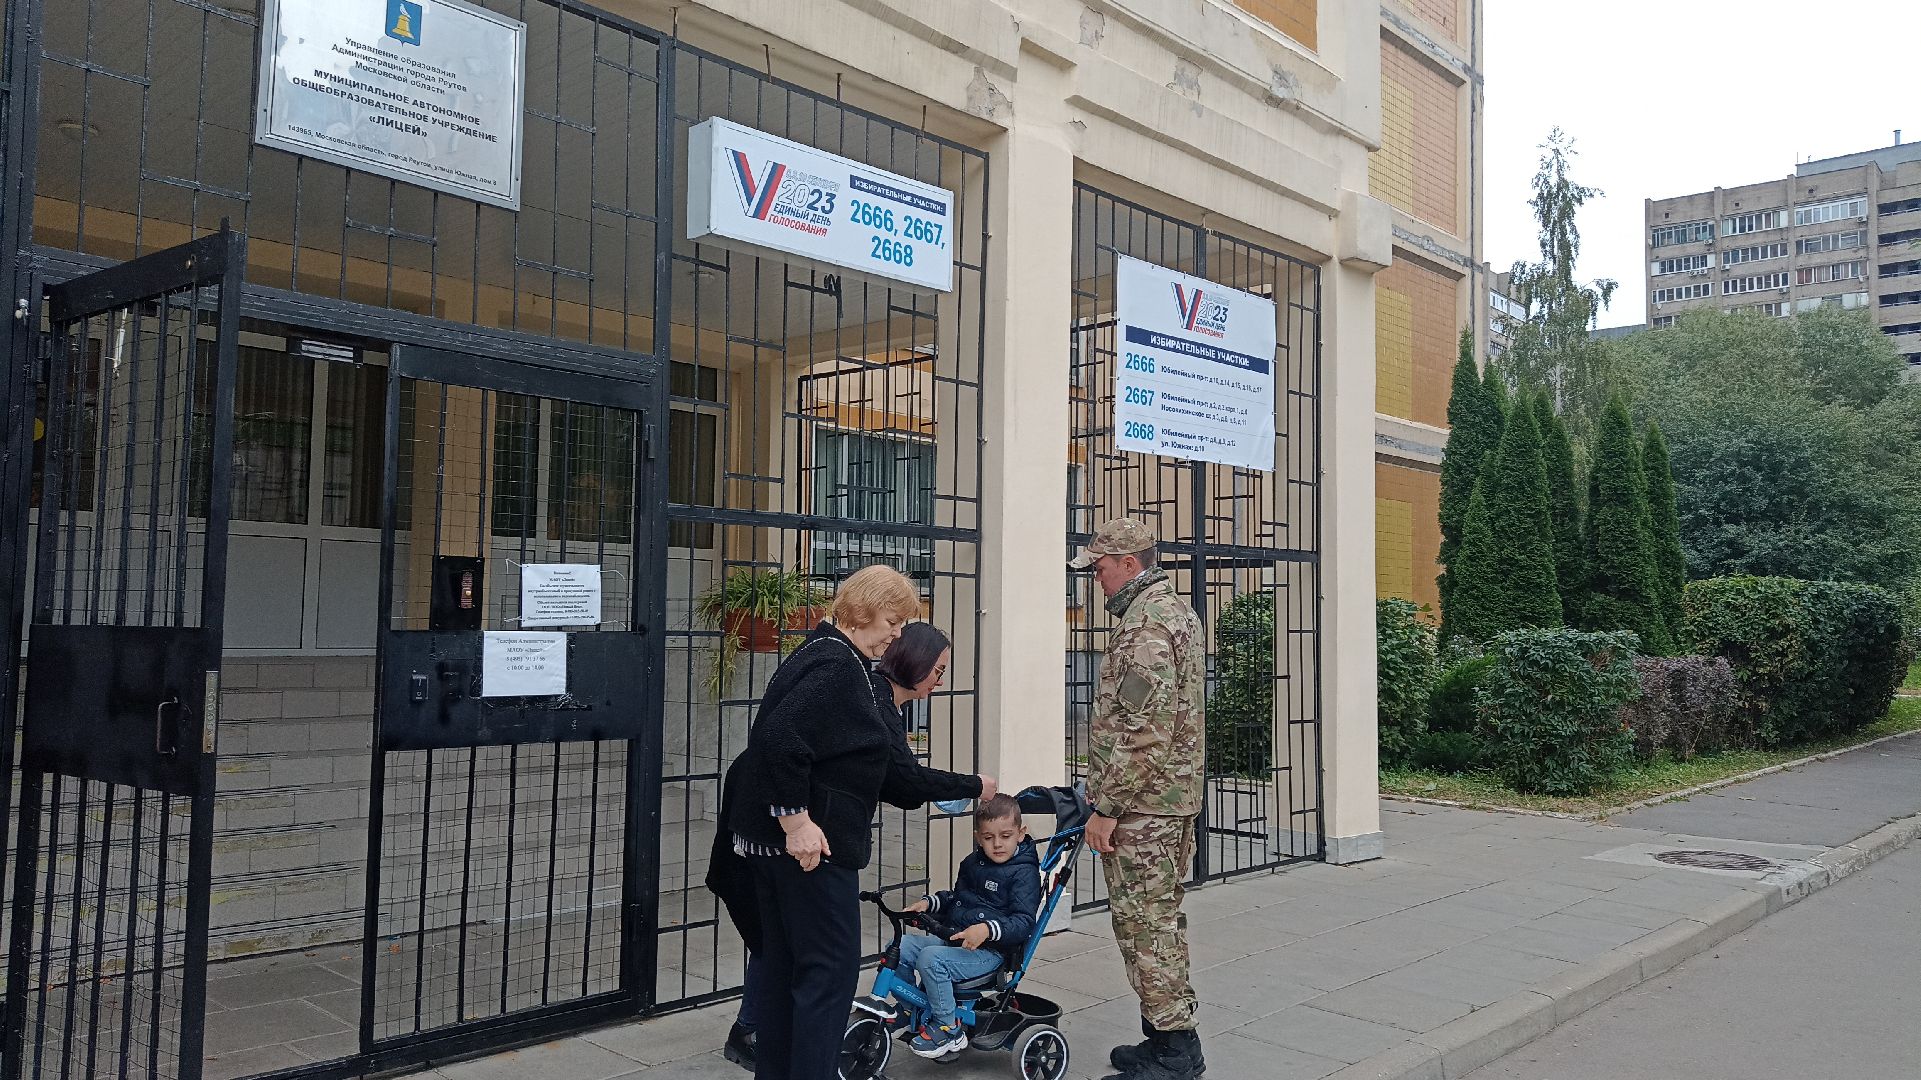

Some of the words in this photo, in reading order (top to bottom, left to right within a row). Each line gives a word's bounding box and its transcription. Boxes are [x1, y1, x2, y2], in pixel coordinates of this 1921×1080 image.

[332, 44, 404, 73] Администрации
[407, 68, 436, 83] города
[438, 77, 467, 93] Реутов
[345, 37, 399, 60] Управление
[400, 57, 456, 79] образования
[355, 60, 408, 84] Московской
[410, 80, 445, 95] области
[292, 76, 429, 123] ОБЩЕОБРАЗОВАТЕЛЬНОЕ
[431, 116, 498, 143] УЧРЕЖДЕНИЕ
[314, 69, 409, 103] МУНИЦИПАЛЬНОЕ
[412, 99, 480, 126] АВТОНОМНОЕ
[368, 115, 428, 138] «ЛИЦЕЙ»
[315, 131, 356, 148] Московская
[778, 179, 837, 215] 2023
[855, 179, 913, 203] ИЗБИРАТЕЛЬНЫЕ
[913, 198, 944, 213] УЧАСТКИ:
[768, 213, 828, 237] ГОЛОСОВАНИЯ
[773, 202, 809, 221] ЕДИНЫЙ
[810, 214, 832, 227] ДЕНЬ
[850, 199, 898, 237] 2666,
[903, 214, 946, 250] 2667,
[871, 235, 914, 267] 2668
[1197, 300, 1229, 324] 2023
[1125, 352, 1155, 374] 2666
[1150, 334, 1216, 359] ИЗБИРАТЕЛЬНЫЕ
[1217, 350, 1250, 367] УЧАСТКИ:
[1161, 365, 1196, 379] Юбилейный
[1125, 385, 1155, 406] 2667
[1161, 391, 1196, 405] Юбилейный
[1125, 420, 1154, 441] 2668
[1161, 427, 1197, 440] Юбилейный
